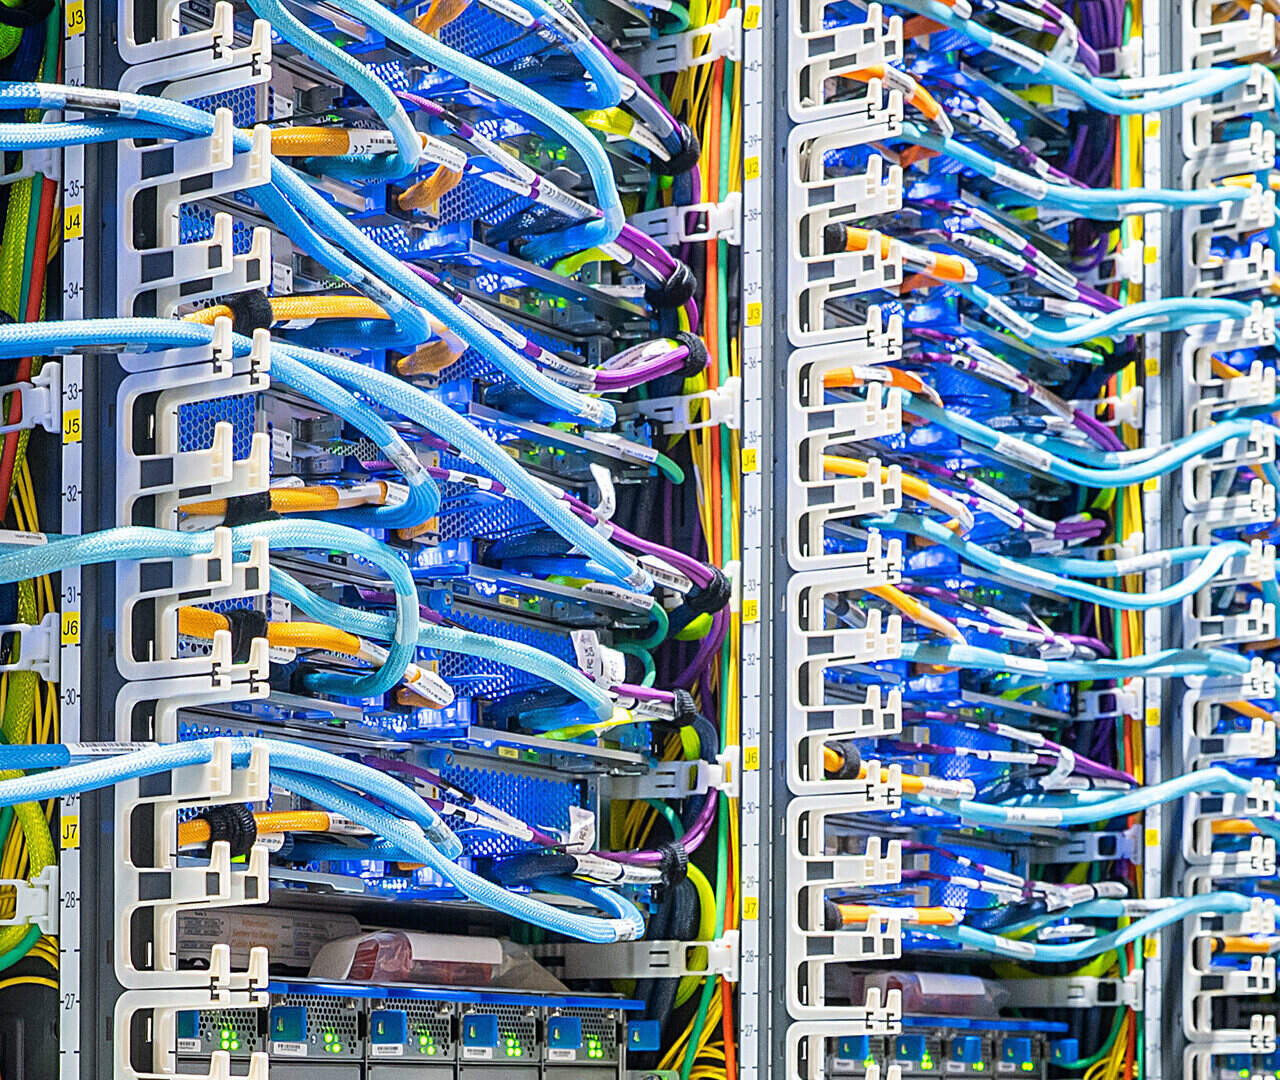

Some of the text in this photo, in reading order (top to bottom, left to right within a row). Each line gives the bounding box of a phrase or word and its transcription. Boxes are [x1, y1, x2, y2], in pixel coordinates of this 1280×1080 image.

[68, 9, 84, 28] J3
[746, 9, 758, 22] J1
[746, 161, 759, 174] J2
[69, 180, 80, 197] 35
[65, 213, 81, 231] J4
[68, 282, 80, 299] 34
[747, 282, 758, 295] 37
[747, 307, 760, 320] J3
[67, 383, 79, 401] 33
[64, 418, 81, 435] J5
[743, 454, 756, 467] J4
[67, 485, 78, 503] 32
[66, 586, 77, 604] 31
[745, 604, 757, 617] J5
[63, 620, 79, 636] J6
[65, 688, 77, 705] 30
[746, 727, 756, 739] 31
[745, 751, 758, 764] J6
[746, 802, 756, 814] 30
[62, 824, 78, 840] J7
[65, 891, 76, 908] 28
[744, 902, 757, 915] J7
[745, 951, 755, 963] 28
[64, 993, 76, 1010] 27
[745, 1025, 754, 1037] 27
